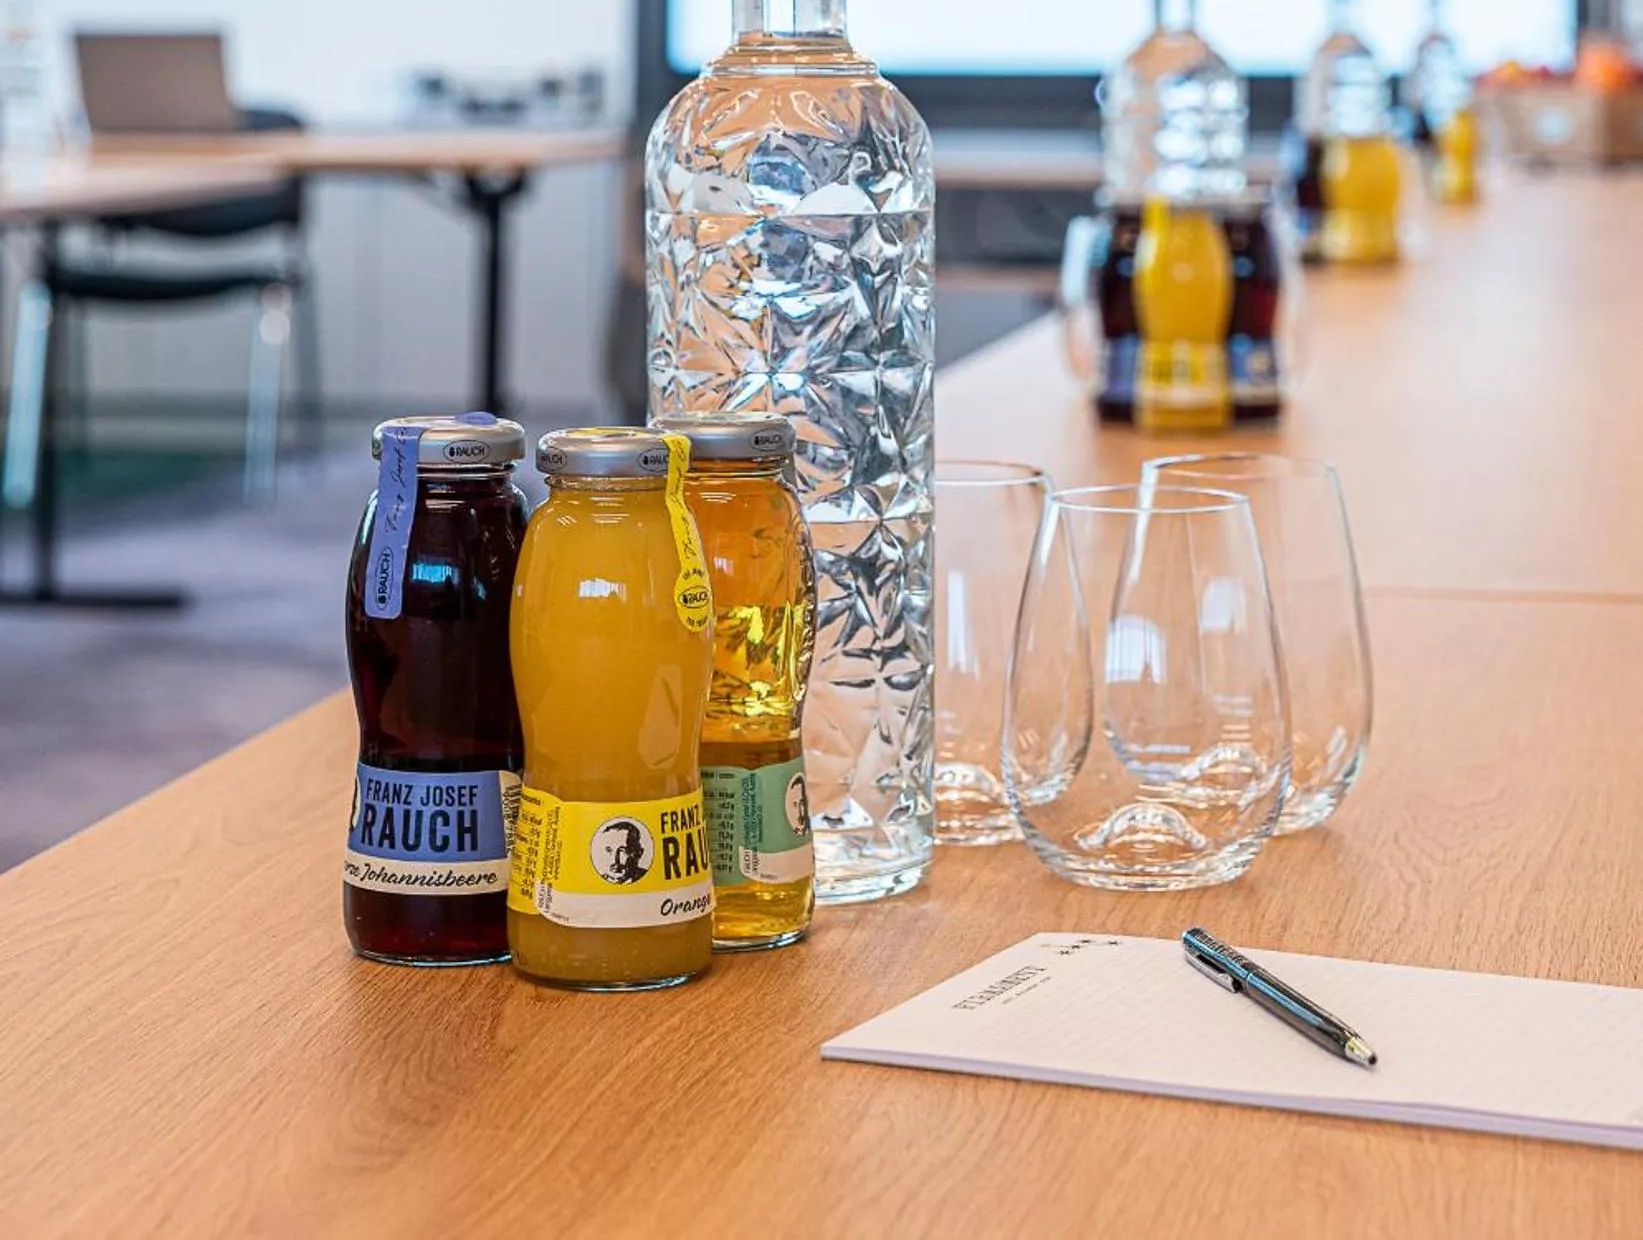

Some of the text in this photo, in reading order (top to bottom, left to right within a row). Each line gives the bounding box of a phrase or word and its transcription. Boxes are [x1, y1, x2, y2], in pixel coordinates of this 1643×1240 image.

[455, 446, 486, 458] RAUCH
[378, 551, 391, 596] RAUCH
[366, 778, 479, 807] FRANZ JOSEF
[361, 803, 479, 853] RAUCH
[660, 804, 701, 833] FRANZ
[662, 826, 710, 880] RAU
[360, 863, 498, 887] Johannisbeere
